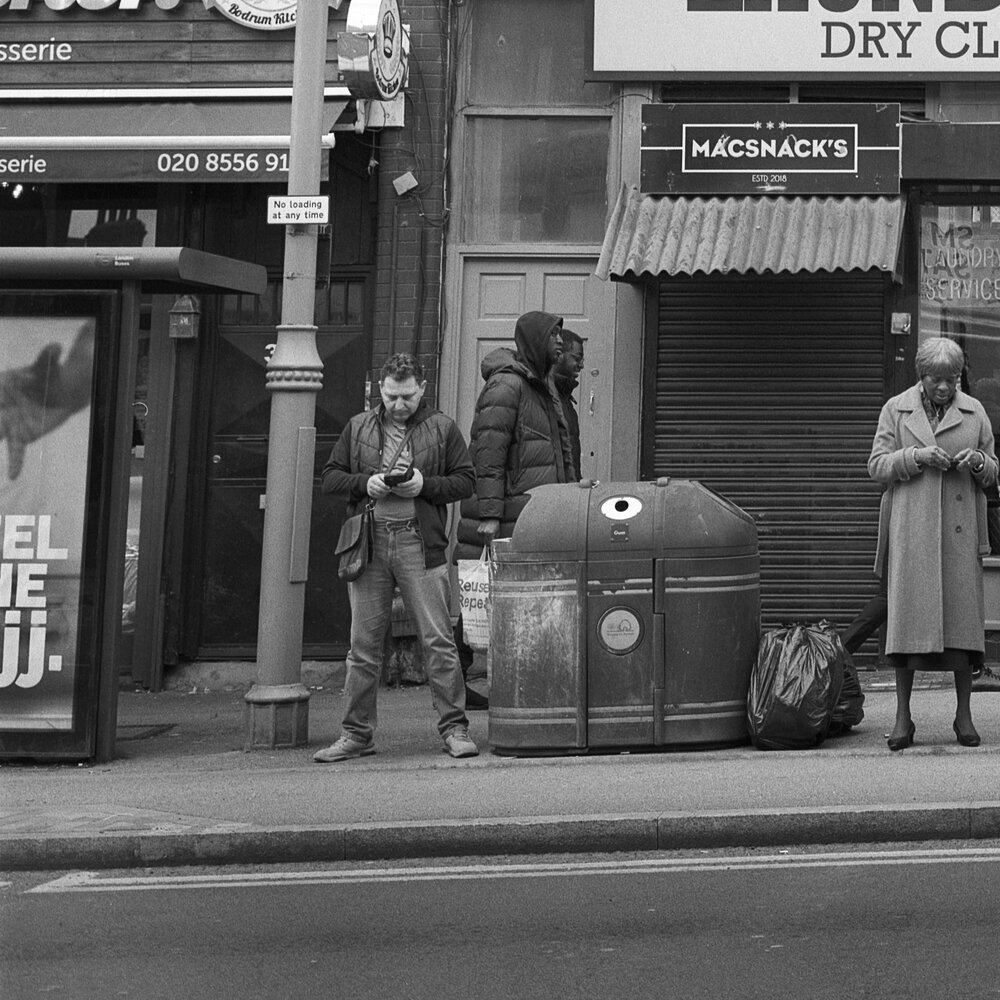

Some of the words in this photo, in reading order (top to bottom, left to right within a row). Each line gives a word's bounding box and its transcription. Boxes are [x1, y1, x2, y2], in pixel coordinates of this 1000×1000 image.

[228, 2, 272, 25] Bodrum
[273, 9, 298, 25] Kitc
[820, 20, 922, 59] DRY
[691, 138, 849, 158] MACSNACK'S
[157, 152, 200, 173] 020
[205, 152, 260, 173] 8556
[264, 153, 290, 173] 91
[751, 174, 769, 183] ESTD
[770, 174, 788, 183] 2018
[273, 200, 287, 209] No
[289, 200, 322, 210] loading
[272, 211, 282, 219] at
[285, 212, 301, 221] any
[304, 210, 325, 219] time
[0, 514, 68, 560] EL
